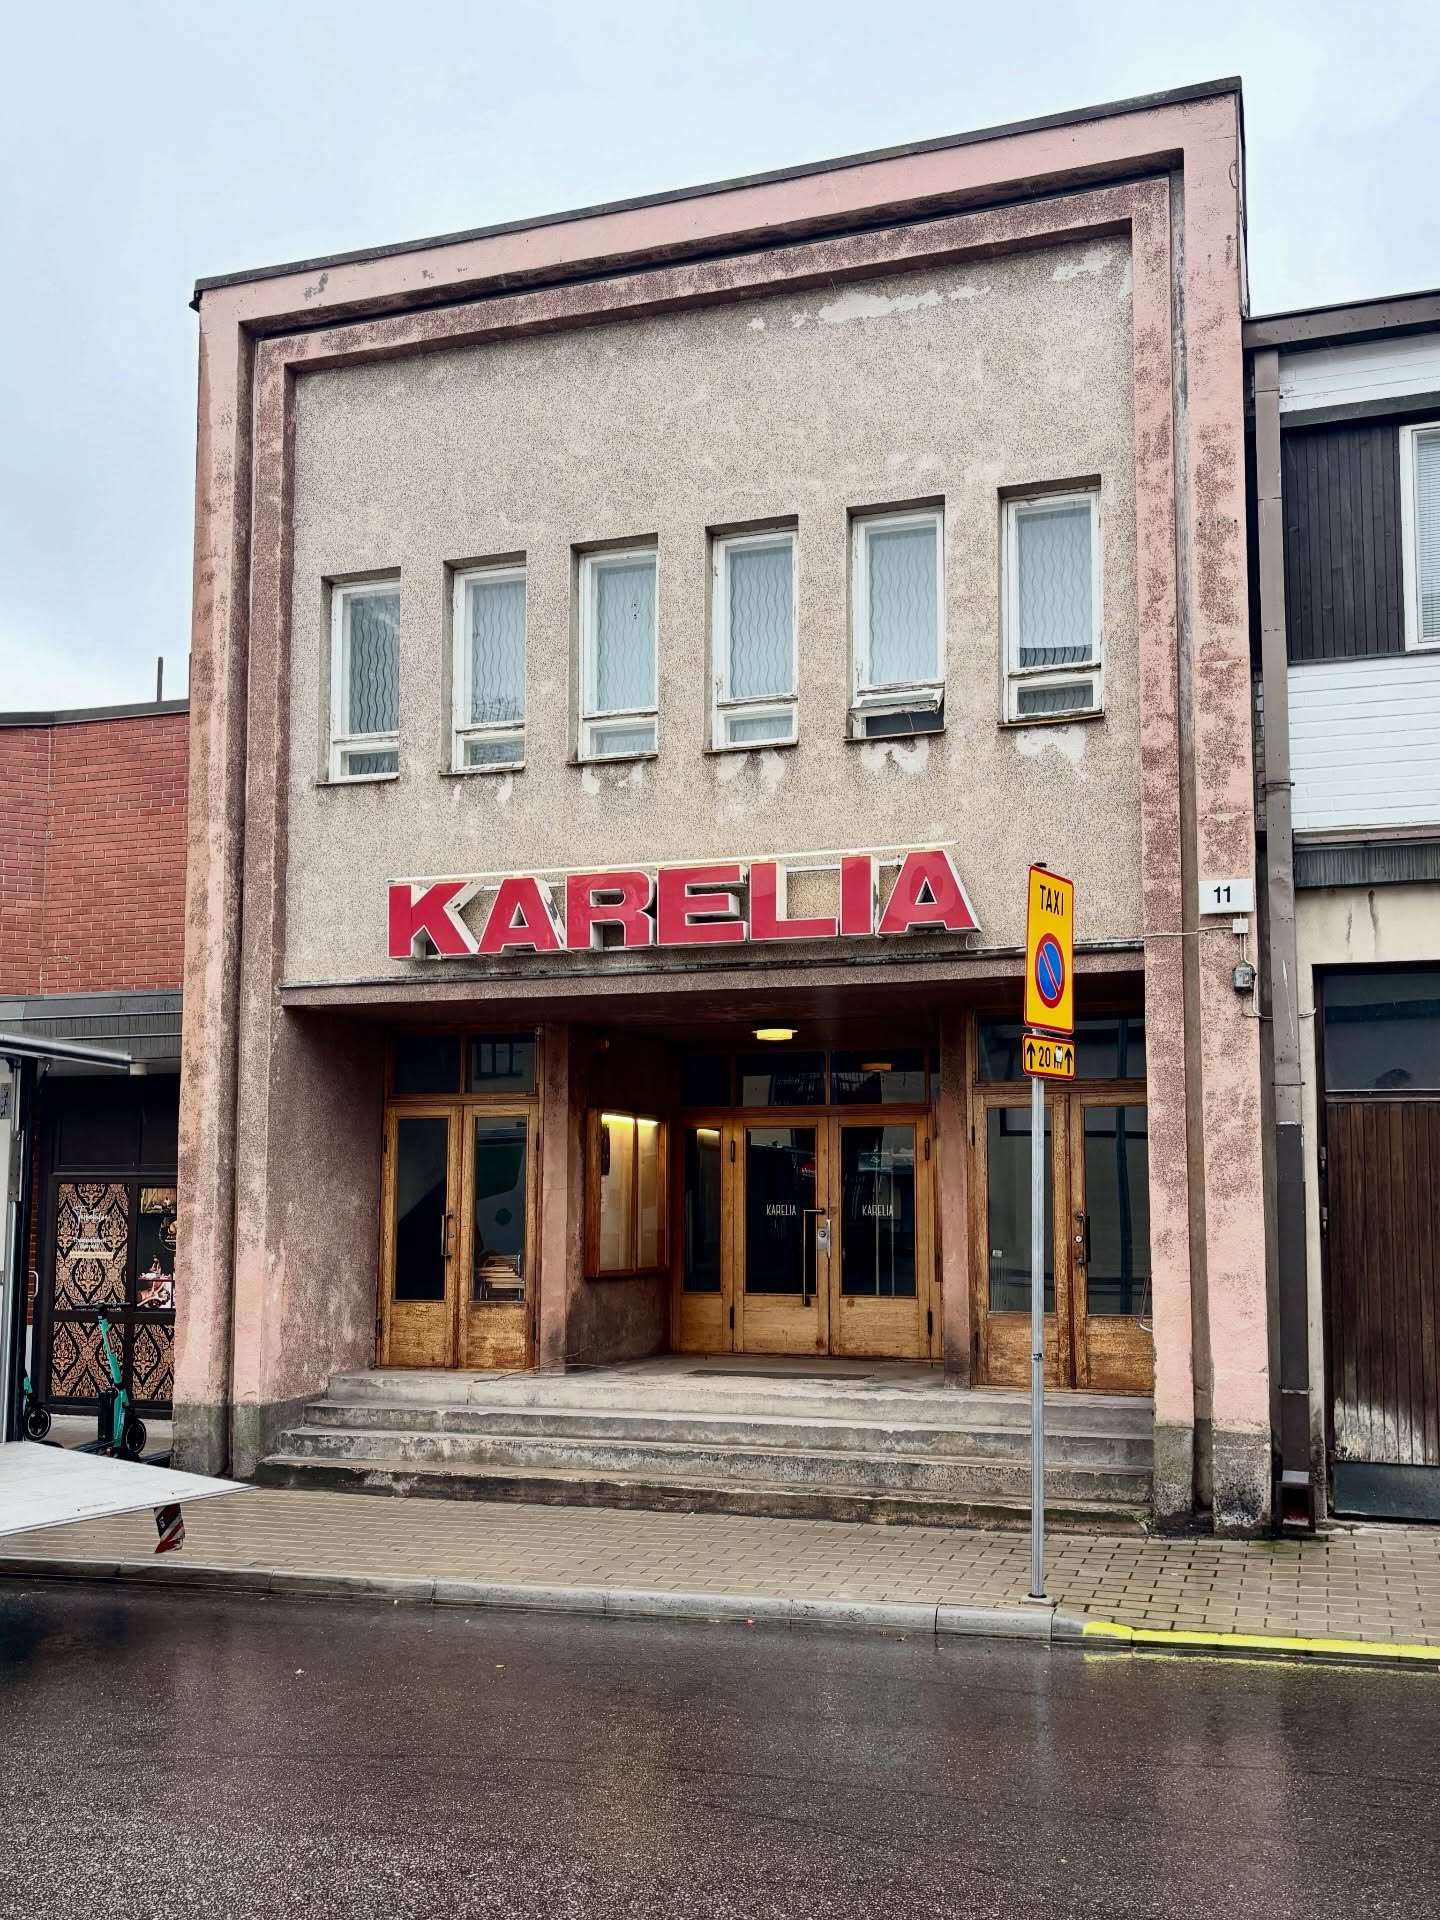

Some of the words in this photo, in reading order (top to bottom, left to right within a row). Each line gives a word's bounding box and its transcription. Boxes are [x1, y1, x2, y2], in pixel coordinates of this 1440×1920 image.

[388, 850, 981, 959] KARELIA
[1040, 884, 1064, 916] TAXI
[1213, 886, 1231, 904] 11
[1038, 1046, 1051, 1068] 20
[766, 1204, 797, 1216] KARELIA
[862, 1204, 894, 1217] KARELIA
